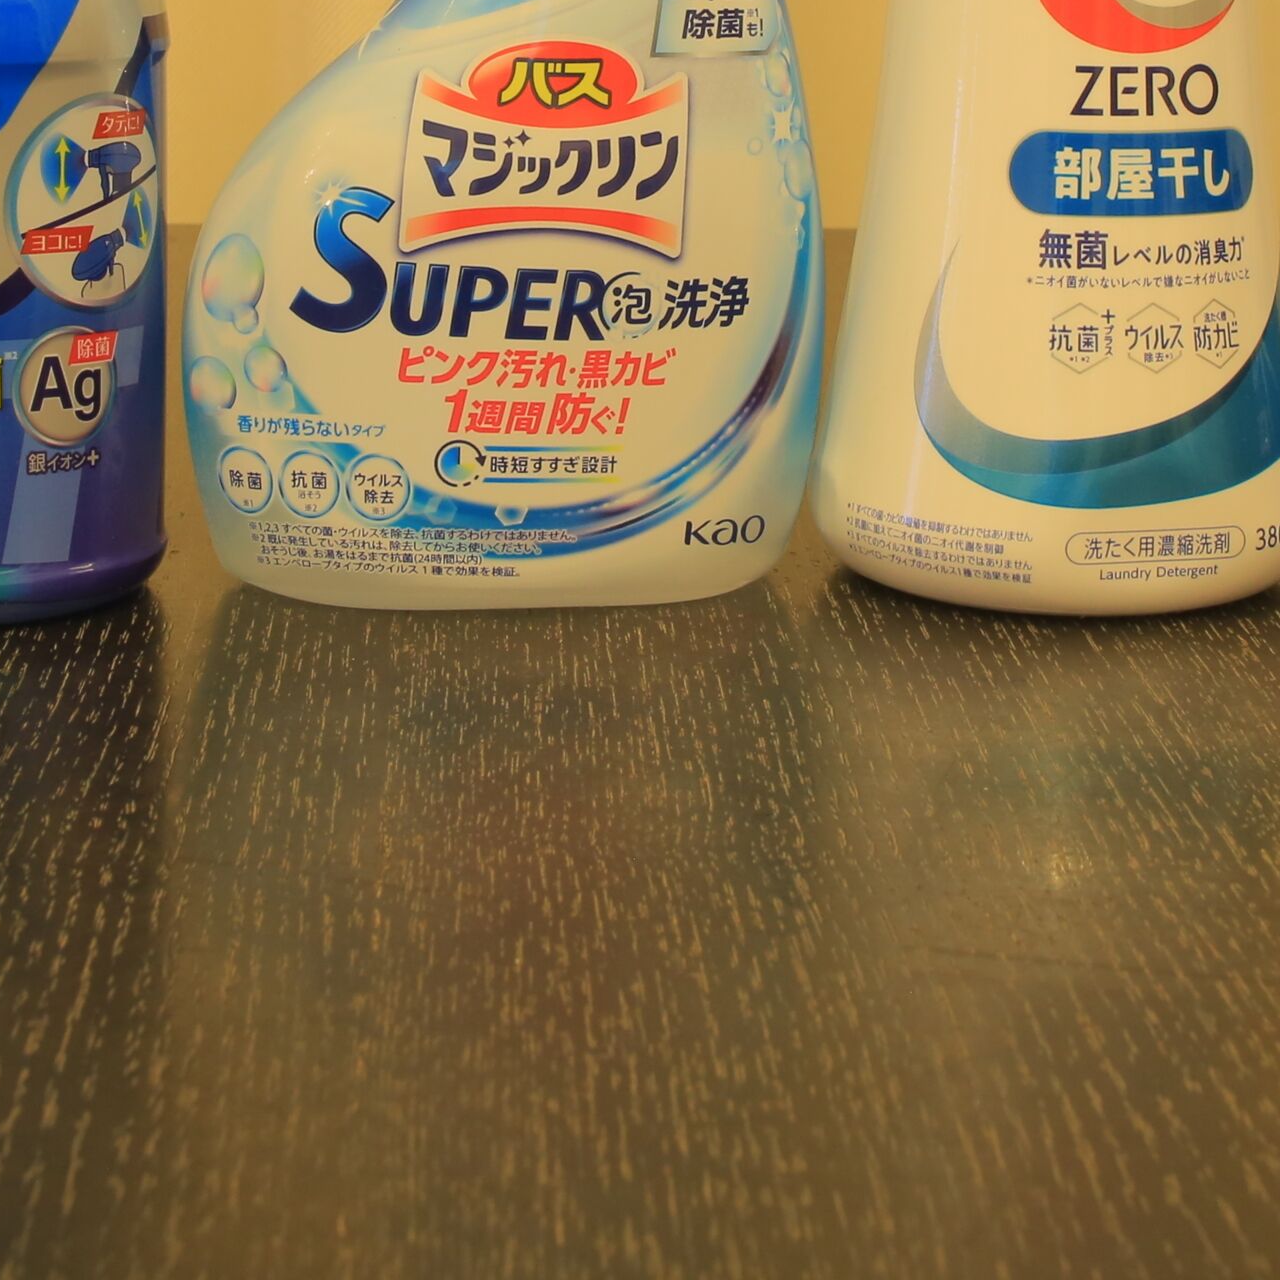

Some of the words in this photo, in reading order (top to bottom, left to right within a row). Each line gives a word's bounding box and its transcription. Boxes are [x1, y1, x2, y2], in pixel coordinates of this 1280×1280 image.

[498, 56, 612, 109] バス
[1070, 63, 1219, 117] ZERO
[422, 119, 679, 201] マジックリン
[1053, 146, 1231, 200] 部屋干し
[31, 233, 83, 252] ヨコに!
[289, 185, 607, 341] SUPER
[76, 335, 111, 359] 除菌
[1049, 324, 1099, 353] 抗菌
[1125, 324, 1185, 350] ウイルス
[1193, 321, 1240, 352] 防カビ
[396, 345, 677, 389] ピンク汚れ・黒カビ
[1144, 352, 1164, 363] 除去
[30, 355, 102, 421] Ag
[237, 414, 386, 438] 香りが残らないタイプ
[489, 455, 618, 474] 時短すすぎ設計
[229, 469, 263, 490] 除菌
[291, 470, 327, 490] 抗菌
[354, 473, 404, 488] ウイルス
[364, 489, 394, 504] 除去
[1084, 531, 1231, 560] 洗たく用濃縮洗剤
[1099, 568, 1152, 582] Laundry
[1156, 563, 1219, 581] Detergent
